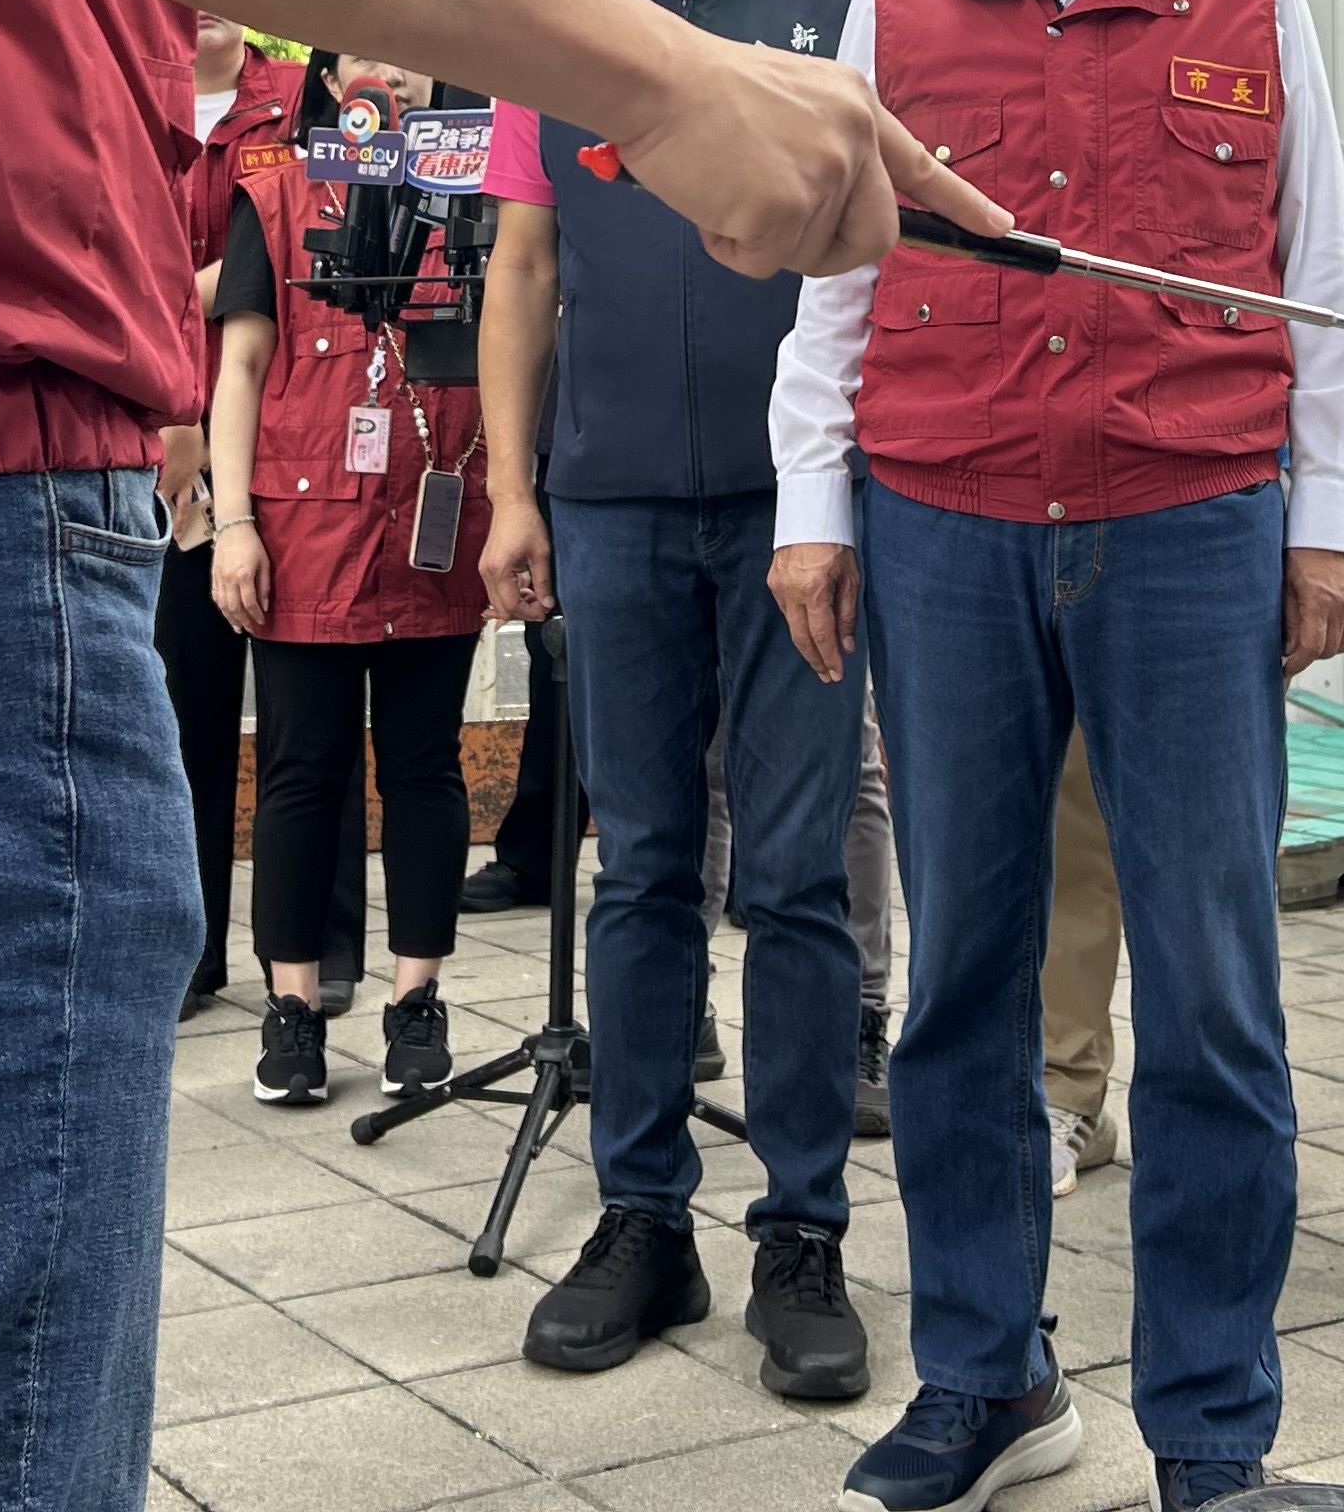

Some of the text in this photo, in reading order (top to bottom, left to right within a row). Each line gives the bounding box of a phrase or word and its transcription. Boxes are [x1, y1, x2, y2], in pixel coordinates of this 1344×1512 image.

[790, 22, 819, 52] 新
[1186, 68, 1255, 105] 市長
[313, 142, 399, 169] ETtoday
